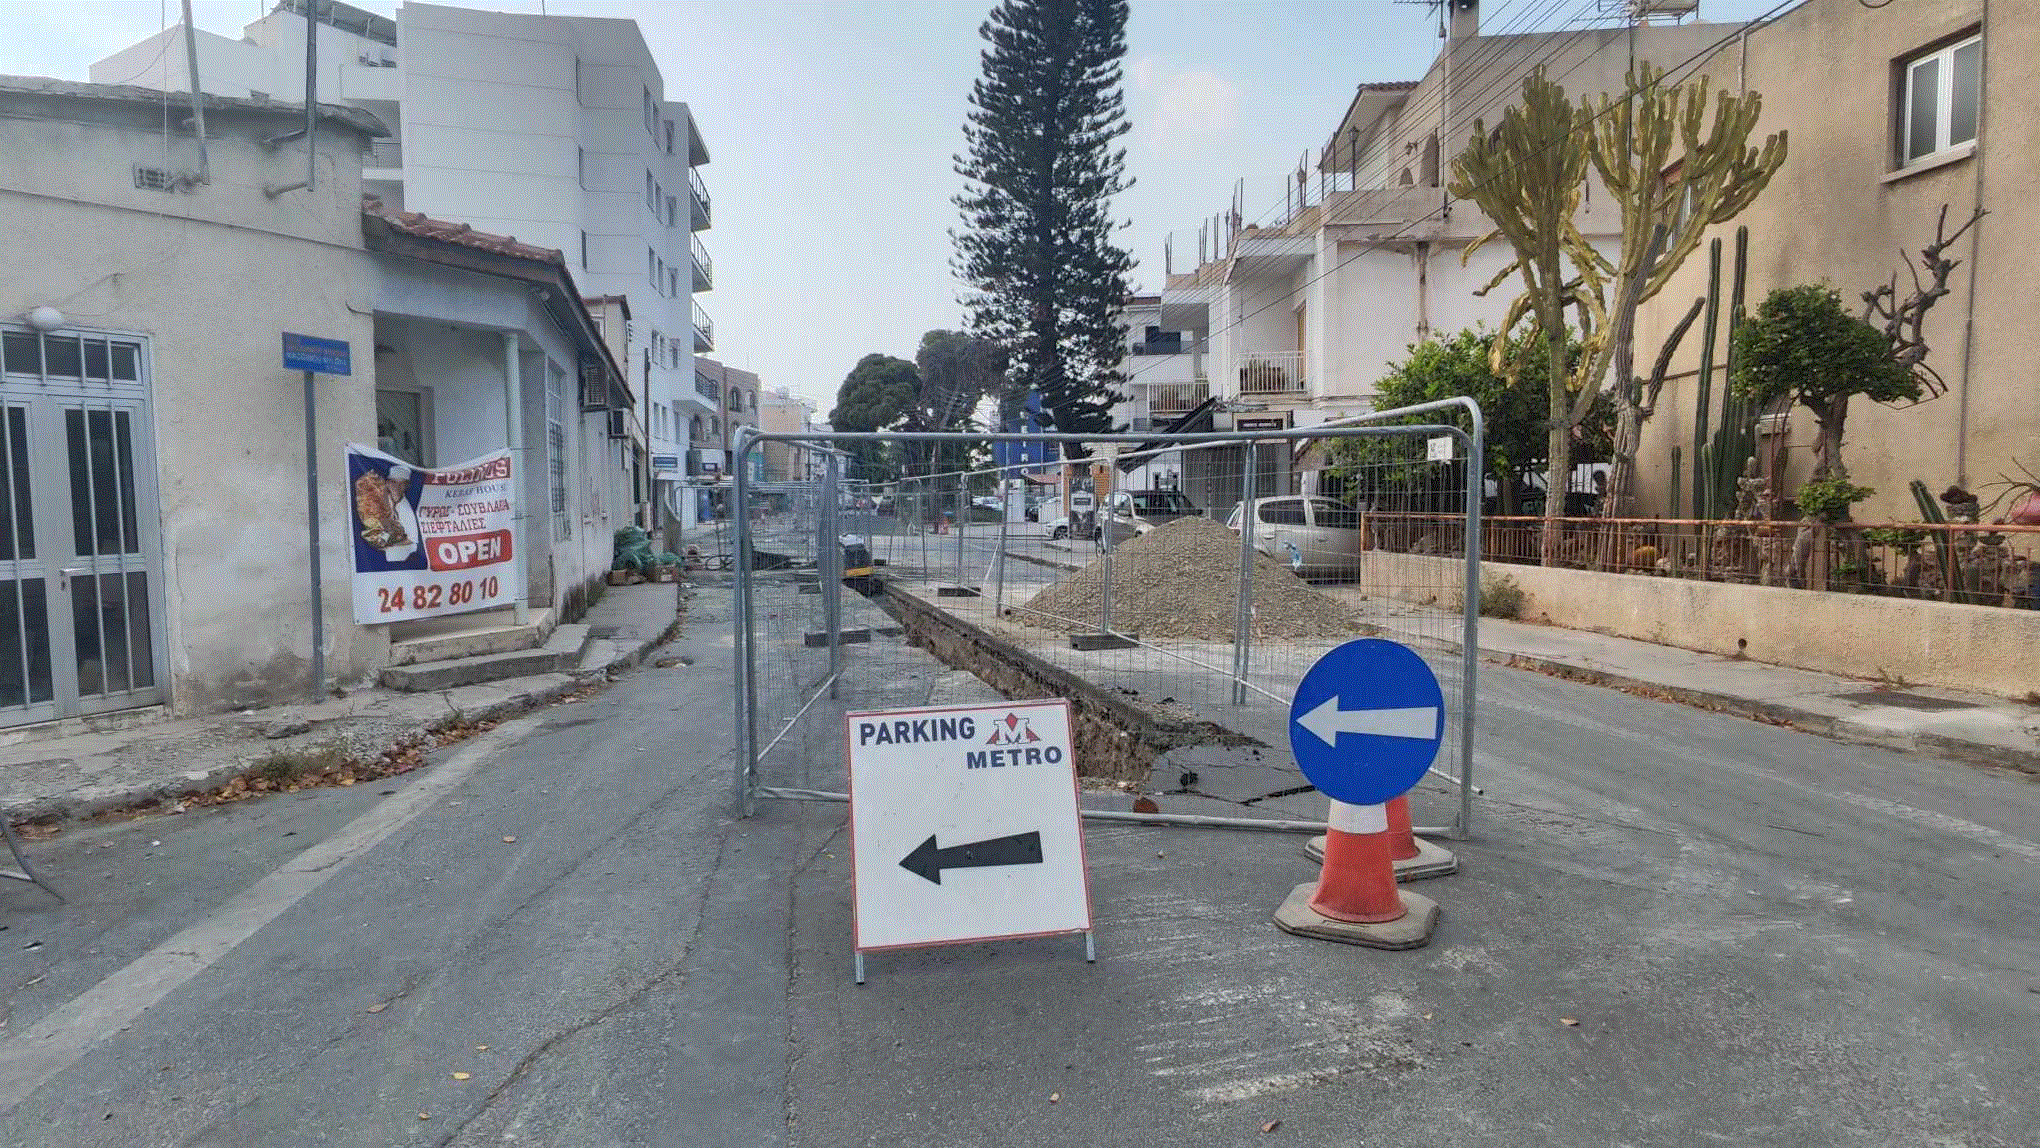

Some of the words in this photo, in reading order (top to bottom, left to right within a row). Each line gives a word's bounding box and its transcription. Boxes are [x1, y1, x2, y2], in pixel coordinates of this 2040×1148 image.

[438, 536, 502, 565] OPEN
[378, 587, 405, 613] 24
[412, 584, 442, 610] 82
[448, 580, 473, 606] 80
[479, 575, 498, 600] 10
[860, 717, 976, 747] PARKING
[966, 746, 1063, 770] METRO
